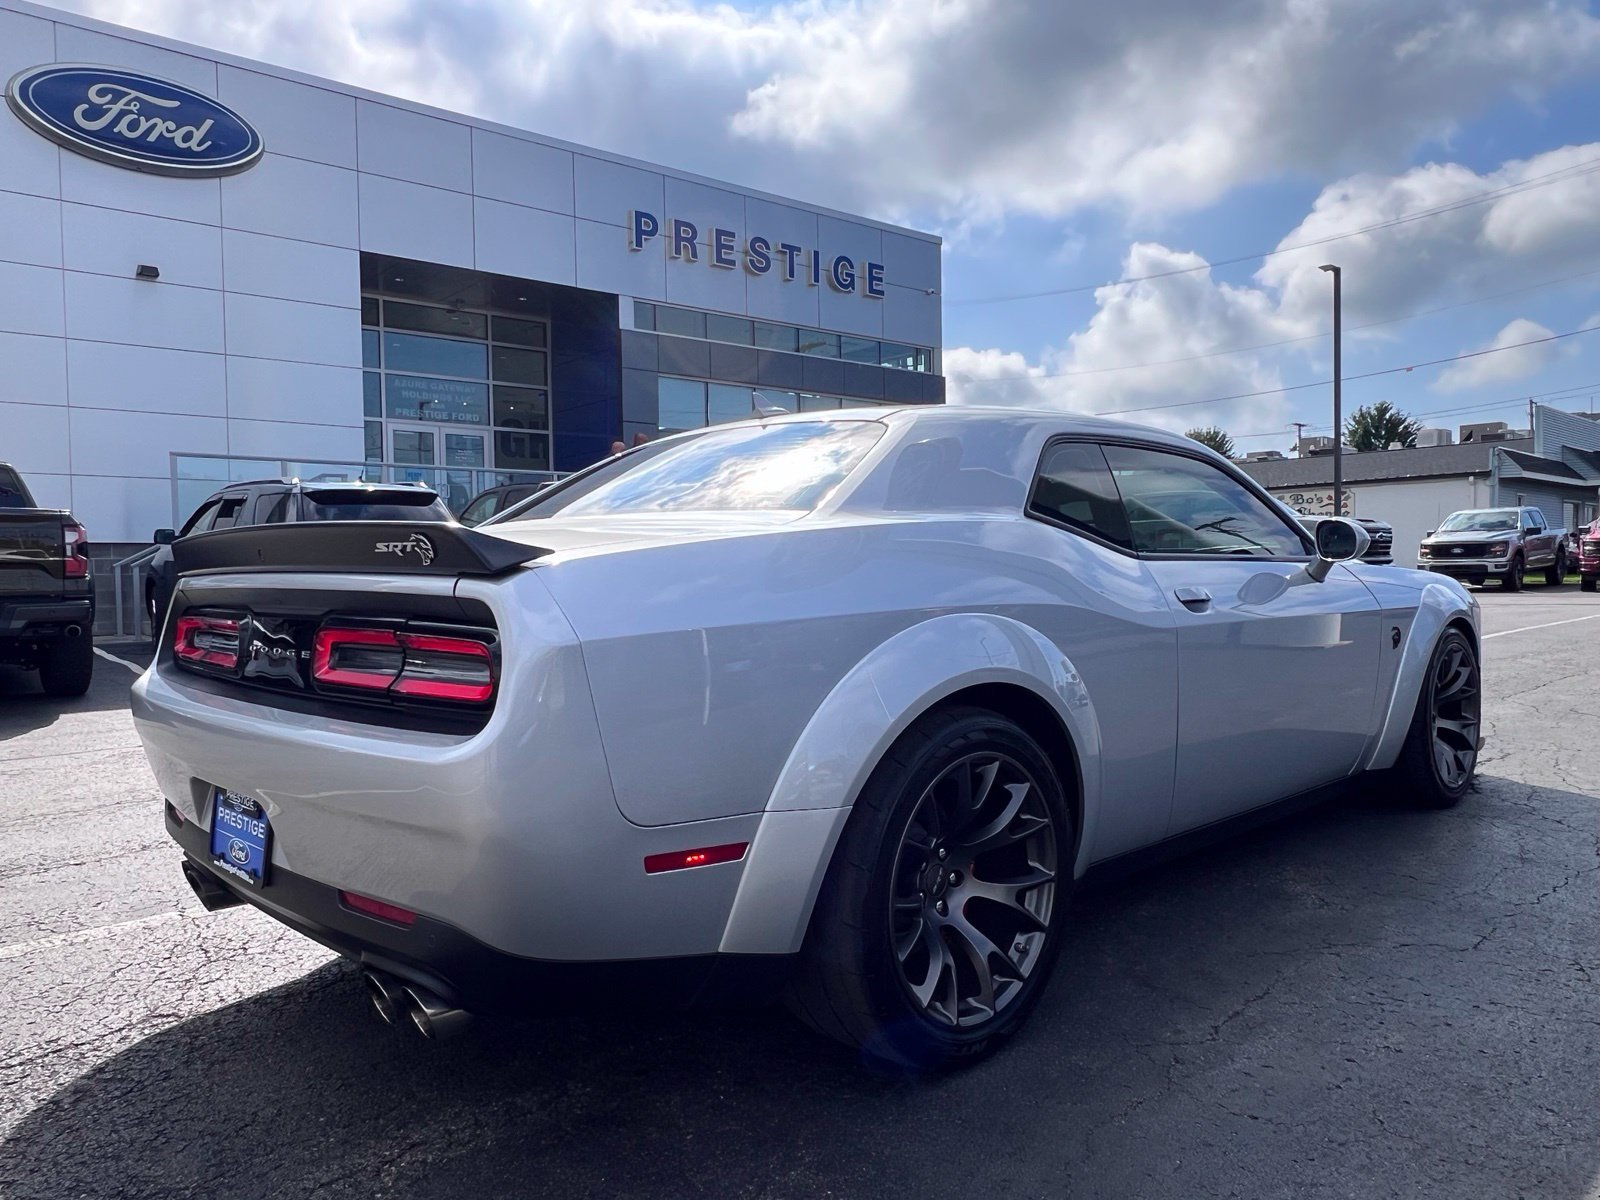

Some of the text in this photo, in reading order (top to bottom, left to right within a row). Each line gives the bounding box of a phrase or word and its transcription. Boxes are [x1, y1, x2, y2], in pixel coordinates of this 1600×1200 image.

[74, 83, 214, 152] Ford
[628, 209, 885, 299] PRESTIGE
[394, 379, 476, 393] AZURE GATEWAY
[401, 390, 452, 402] HOLDINGS
[394, 408, 480, 422] PRESTIGE FORD
[1289, 493, 1324, 505] Bo's
[374, 542, 417, 556] SRT
[226, 791, 256, 808] PRESTIGE
[218, 806, 265, 839] PRESTIGE
[231, 840, 247, 861] Ford
